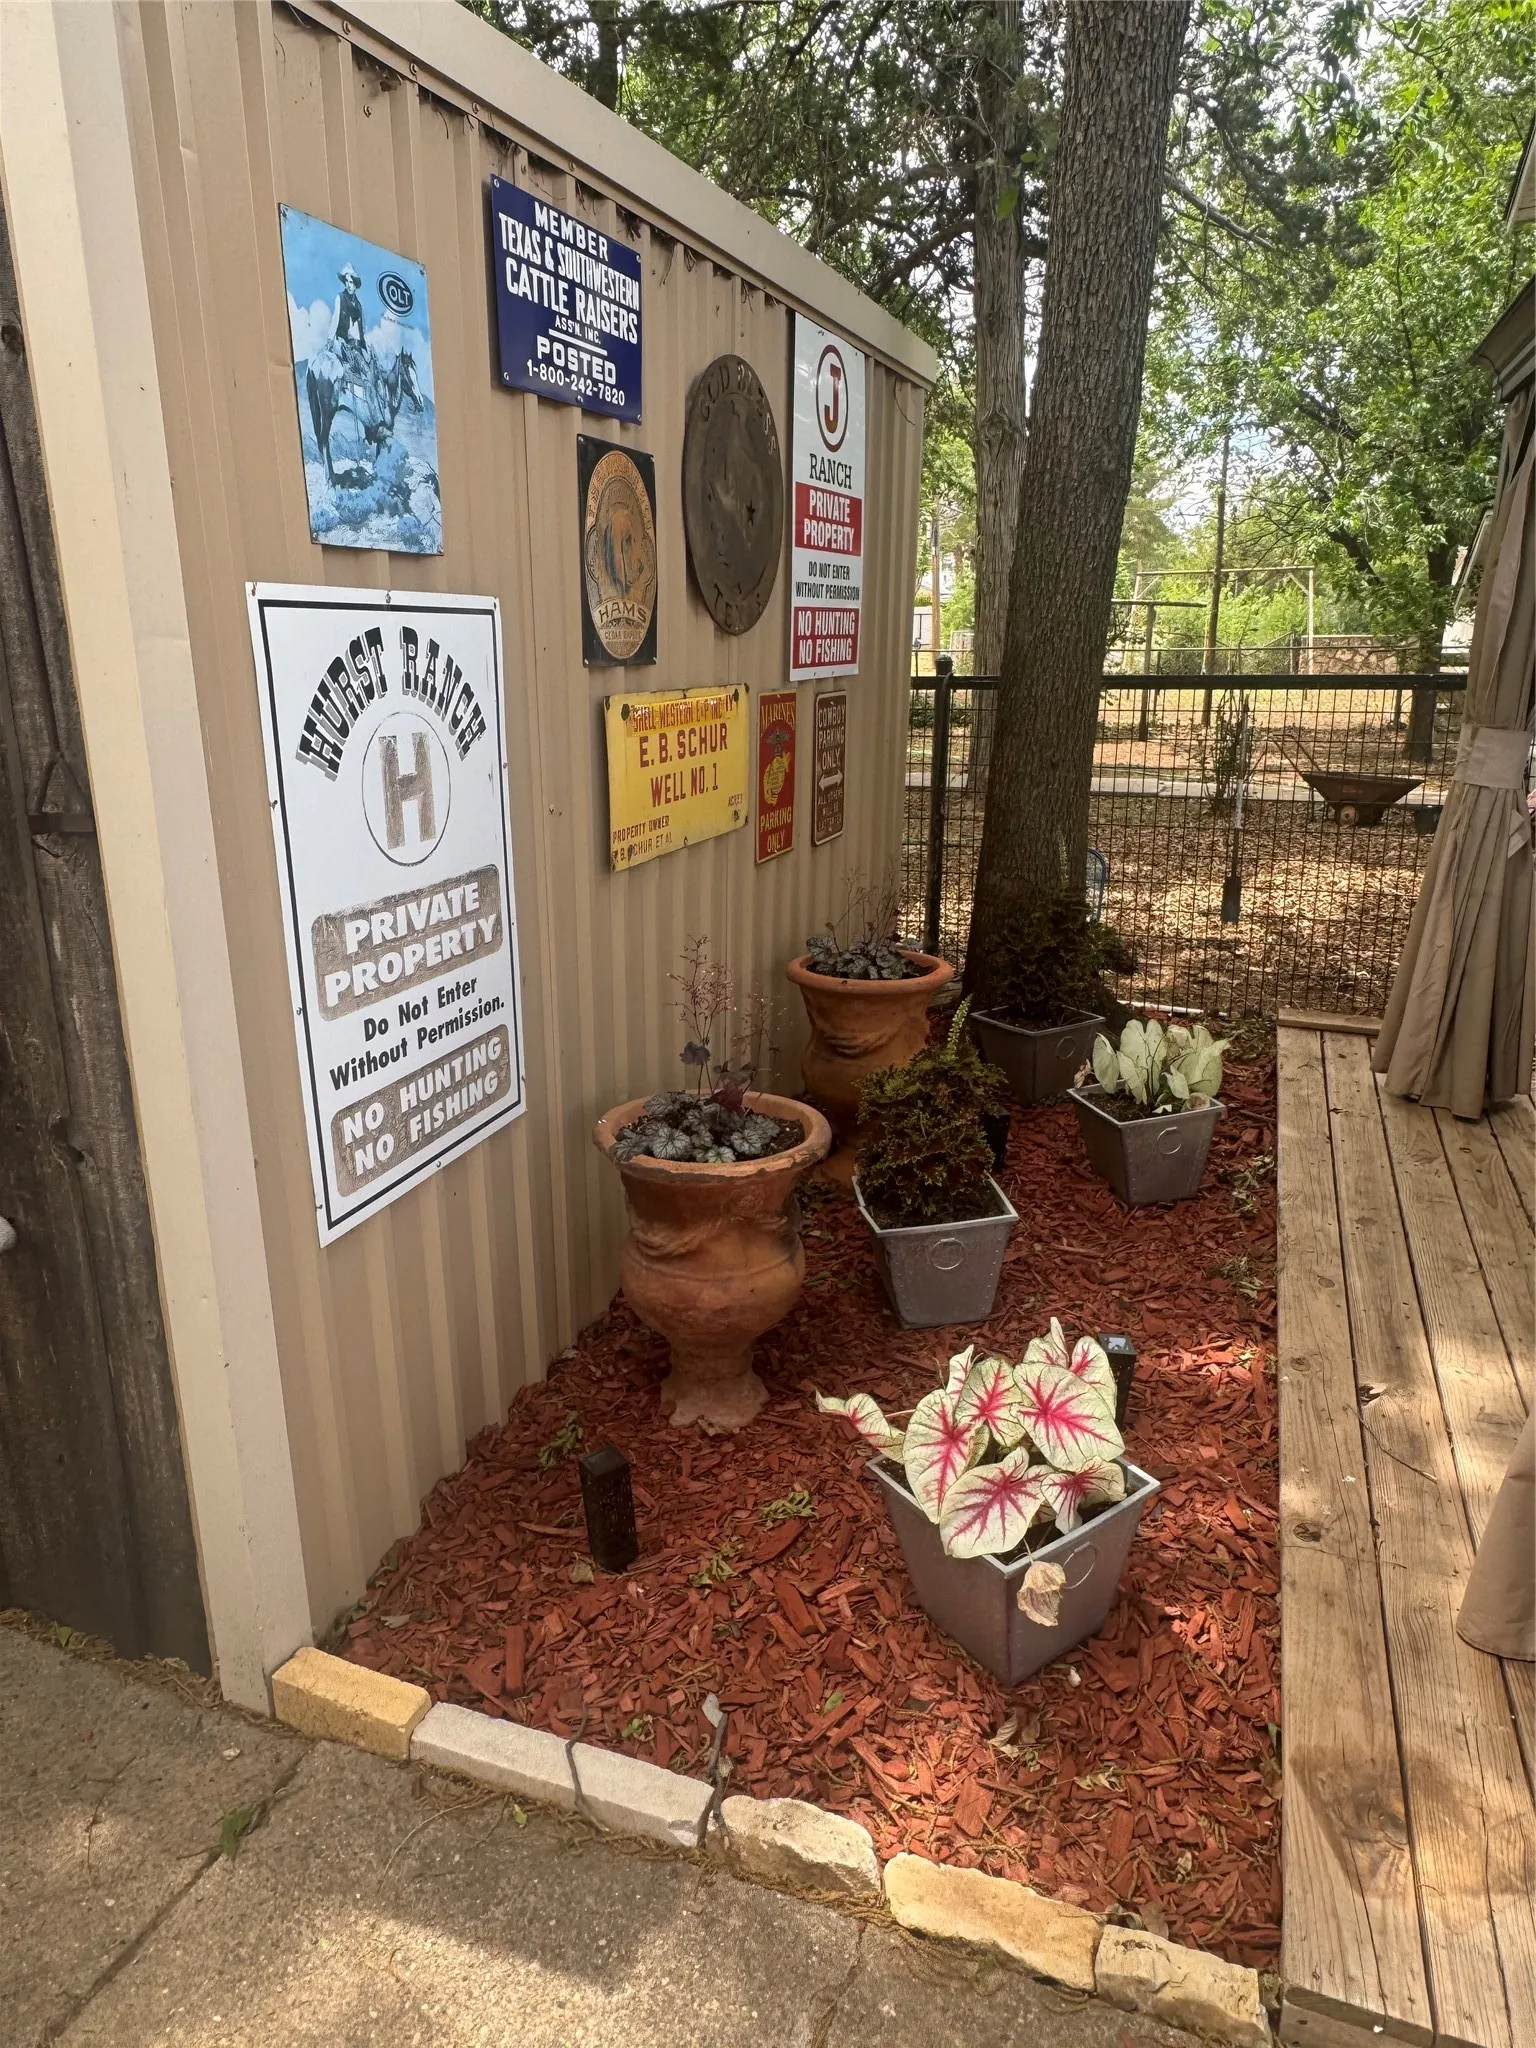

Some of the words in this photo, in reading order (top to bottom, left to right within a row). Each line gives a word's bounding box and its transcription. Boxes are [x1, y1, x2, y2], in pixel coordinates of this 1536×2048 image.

[534, 201, 608, 262] MEMBER
[499, 212, 541, 265] TEXAS
[544, 236, 555, 272] &
[557, 242, 639, 311] SOUTHWESTERN
[381, 275, 411, 311] COLT
[506, 257, 569, 316] CATTLE
[575, 287, 638, 344] RAISERS
[584, 325, 601, 344] INC.
[536, 335, 616, 385] POSTED
[527, 359, 625, 406] 1-800-242-7820
[824, 363, 841, 434] J
[809, 453, 852, 489] RANCH
[809, 489, 850, 523] PRIVATE
[804, 519, 854, 551] PROPERTY
[808, 561, 817, 576] DO
[819, 563, 831, 579] NOT
[832, 565, 850, 580] ENTER
[796, 581, 825, 600] WITHOUT
[825, 583, 860, 601] PERMISSION
[598, 601, 647, 624] HAMS
[798, 611, 812, 636] NO
[815, 610, 855, 636] HUNTING
[799, 639, 812, 664] NO
[816, 637, 852, 663] FISHING
[295, 627, 388, 782] HURST
[400, 626, 487, 762] RANCH
[760, 702, 795, 736] MARINES
[818, 704, 845, 728] COWBOY
[677, 722, 728, 760] SCHUR
[818, 726, 845, 750] PARKING
[822, 748, 841, 770] ONLY
[378, 731, 436, 850] H
[651, 771, 686, 808] WELL
[690, 766, 708, 797] NO.
[712, 763, 719, 790] 1
[612, 819, 646, 844] PROPERTY
[760, 806, 792, 832] PARKING
[628, 838, 653, 860] CHUR
[767, 830, 785, 853] ONLY
[344, 882, 479, 955] PRIVATE
[324, 914, 497, 1008] PROPERTY
[363, 1017, 389, 1042] Do
[399, 996, 428, 1027] Not
[437, 977, 477, 1008] Enter
[330, 1039, 409, 1091] Without
[417, 998, 505, 1050] Permission.
[343, 1102, 384, 1145] NO
[400, 1036, 501, 1113] HUNTING
[354, 1133, 394, 1175] NO
[409, 1071, 498, 1142] FISHING
